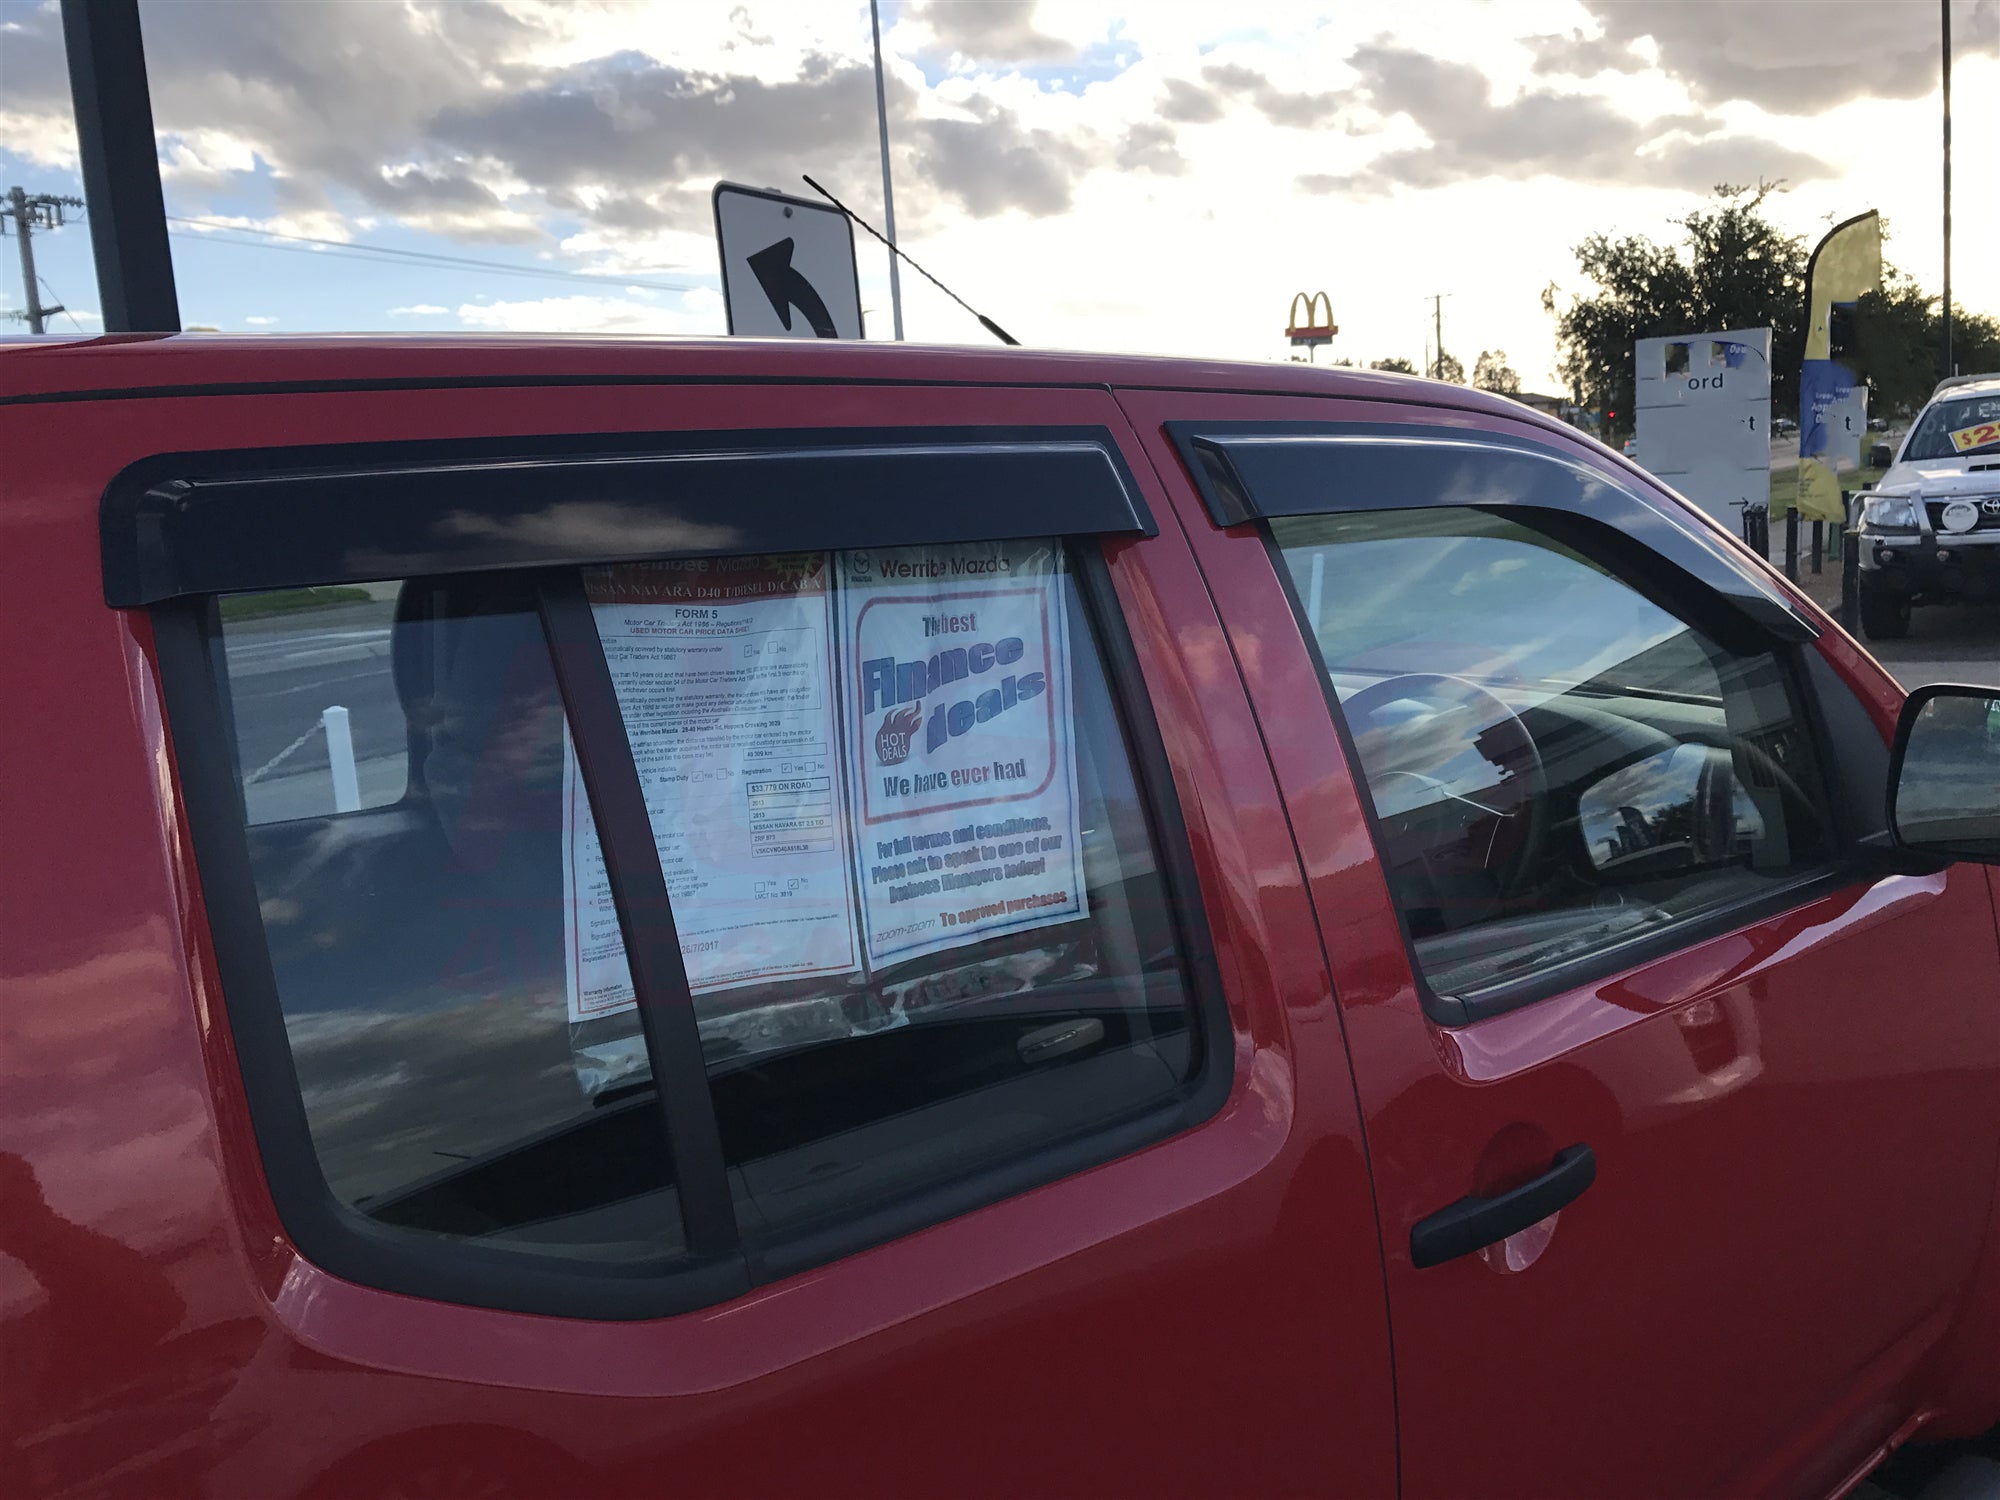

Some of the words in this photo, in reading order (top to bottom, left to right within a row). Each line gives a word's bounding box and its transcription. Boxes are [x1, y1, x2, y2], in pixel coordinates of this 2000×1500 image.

[1962, 421, 2000, 446] $2
[951, 556, 1010, 575] Mazda
[697, 586, 721, 598] D40
[675, 609, 709, 619] FORM
[711, 610, 718, 619] 5
[941, 613, 976, 633] best
[678, 628, 694, 636] CAR
[695, 628, 716, 636] PRICE
[717, 627, 734, 635] DATA
[863, 637, 1024, 715] Finance
[880, 733, 906, 749] HOT
[881, 747, 908, 761] DEALS
[778, 782, 790, 790] ON
[791, 781, 811, 789] ROAD
[883, 777, 910, 797] We
[913, 771, 947, 794] have
[950, 766, 990, 786] ever
[992, 758, 1026, 780] had
[893, 837, 911, 855] full
[953, 825, 975, 844] and
[940, 912, 956, 927] To
